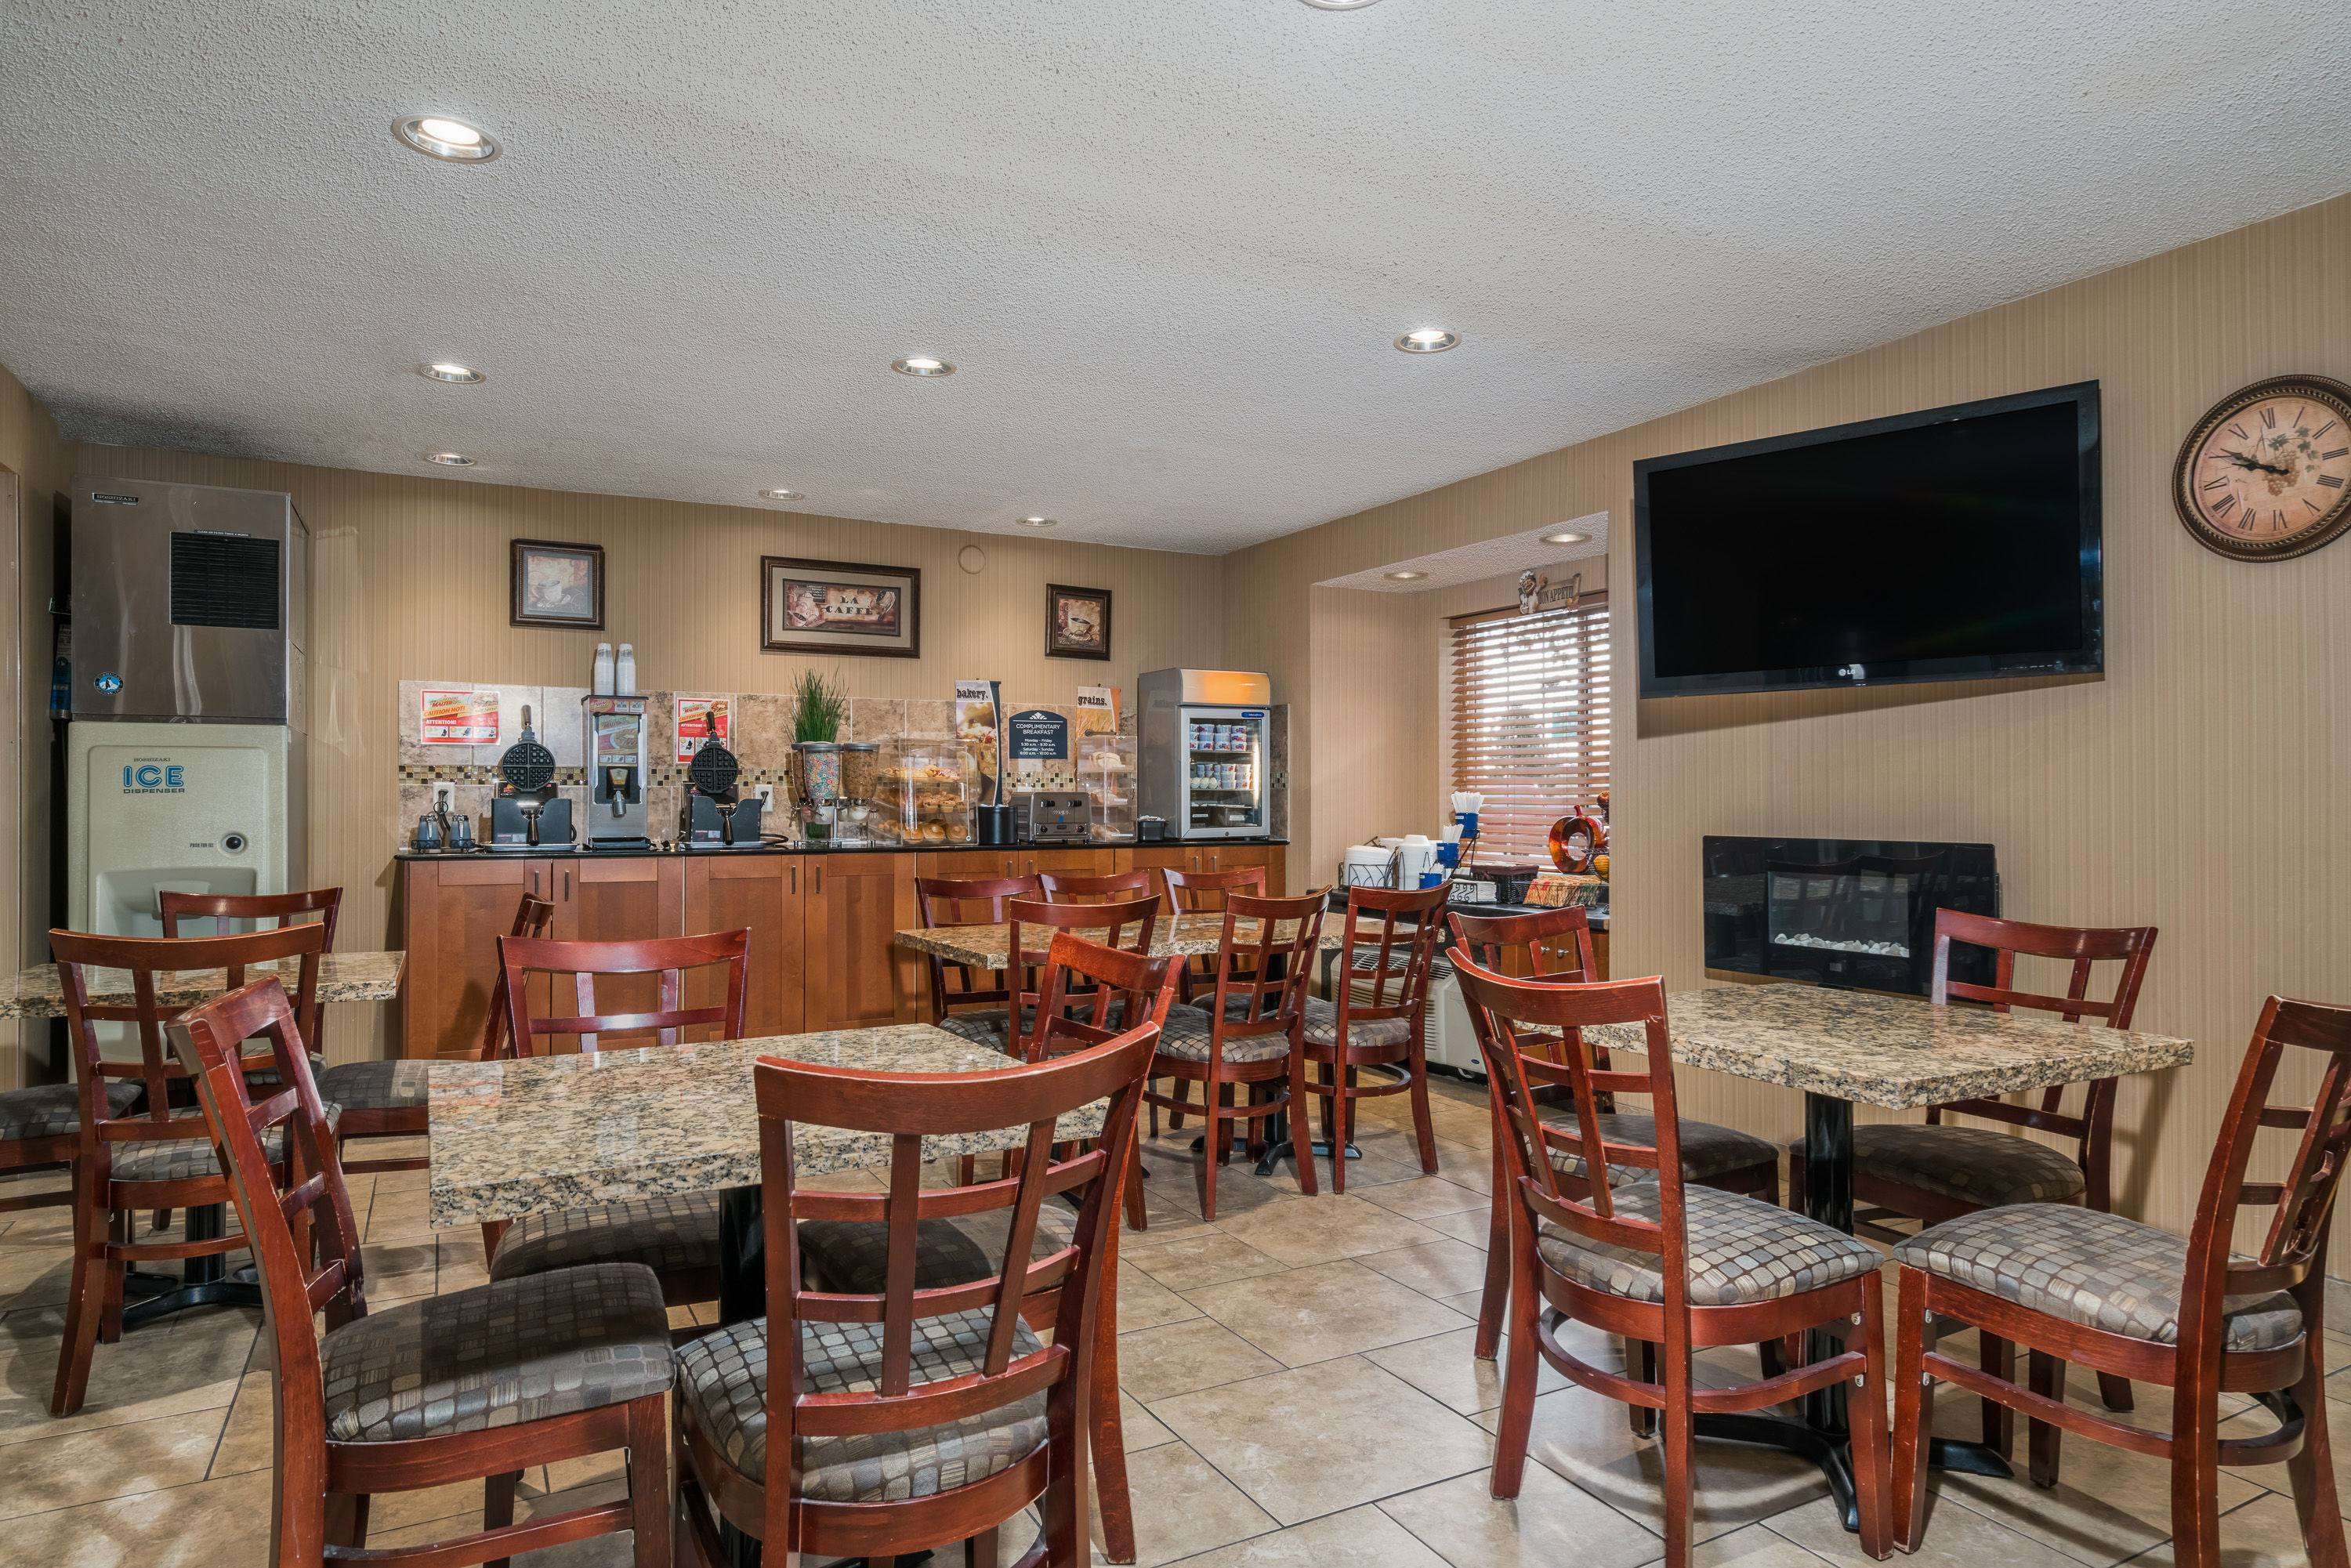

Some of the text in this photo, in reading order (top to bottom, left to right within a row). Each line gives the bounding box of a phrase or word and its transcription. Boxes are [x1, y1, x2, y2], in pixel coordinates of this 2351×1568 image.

[824, 606, 873, 615] CAFFE
[956, 688, 988, 701] bakery.
[1078, 696, 1107, 706] grains.
[424, 707, 451, 717] CAUTION
[124, 766, 184, 788] ICE
